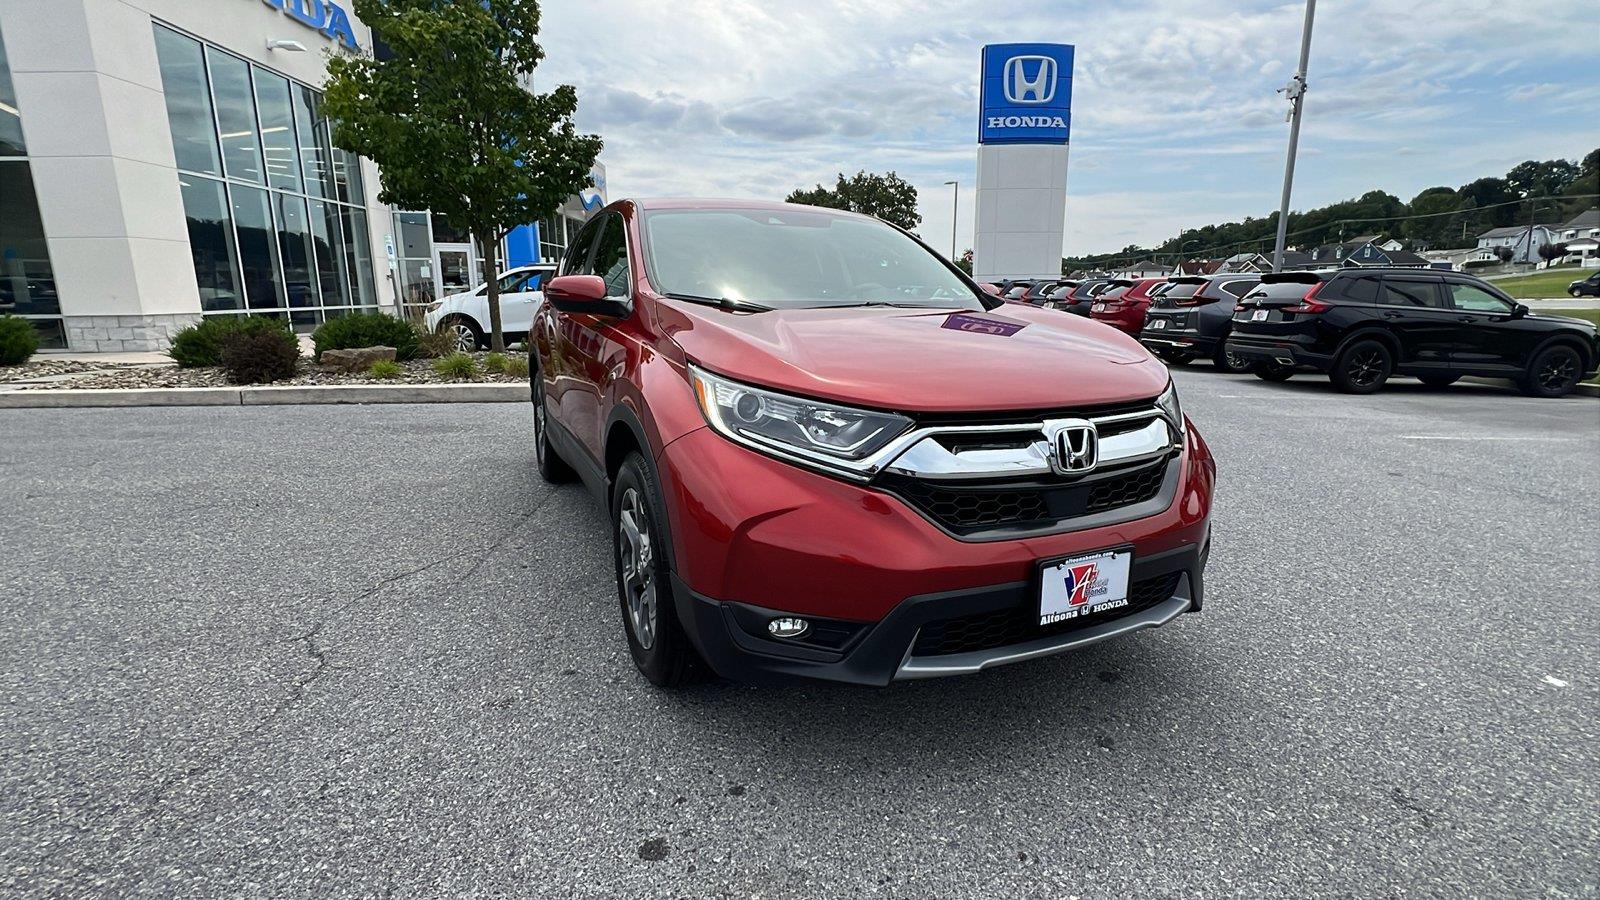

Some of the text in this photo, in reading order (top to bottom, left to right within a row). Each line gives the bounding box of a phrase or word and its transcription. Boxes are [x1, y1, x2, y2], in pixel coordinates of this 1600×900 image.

[262, 0, 361, 51] DA
[987, 116, 1067, 128] HONDA
[1040, 598, 1128, 625] Altoona HONDA
